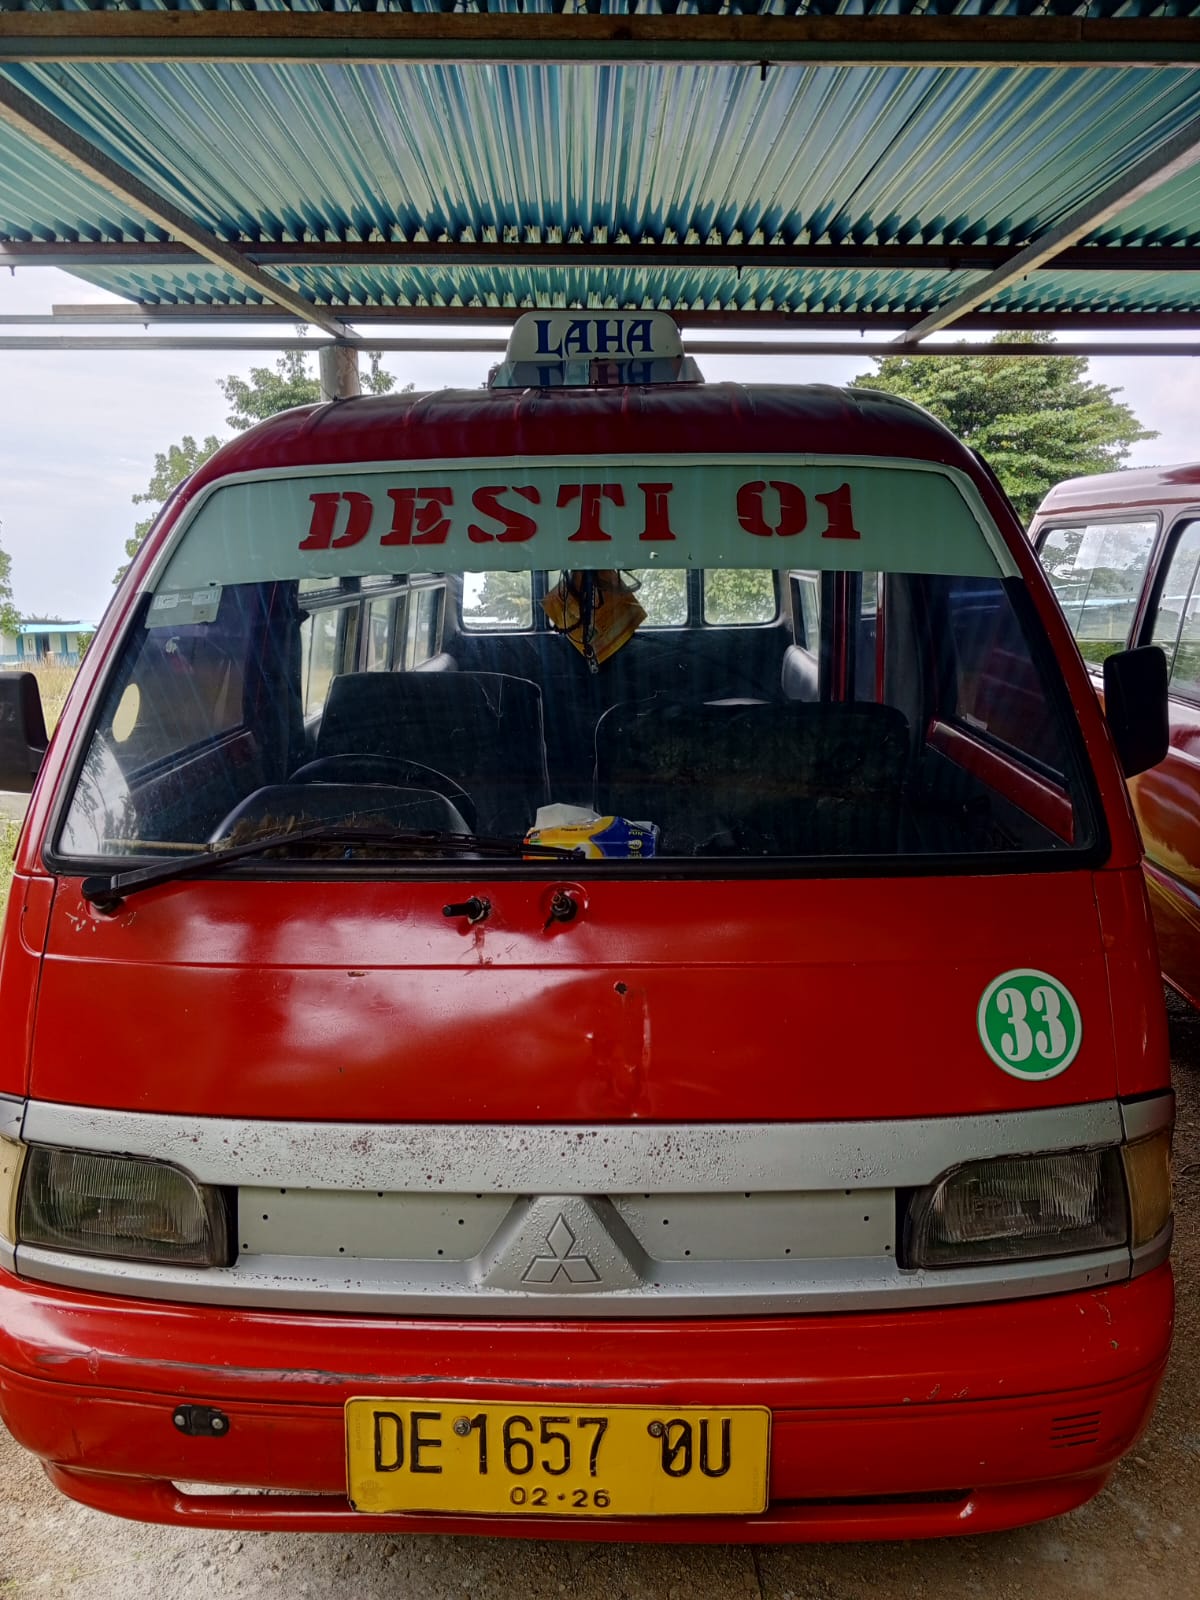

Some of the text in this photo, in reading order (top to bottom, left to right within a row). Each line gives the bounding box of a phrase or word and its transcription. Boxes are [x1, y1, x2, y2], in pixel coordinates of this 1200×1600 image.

[533, 319, 655, 359] LAHA
[298, 480, 861, 550] DESTI 01
[996, 985, 1067, 1062] 33
[373, 1411, 443, 1474] DE
[470, 1413, 609, 1477] 1657
